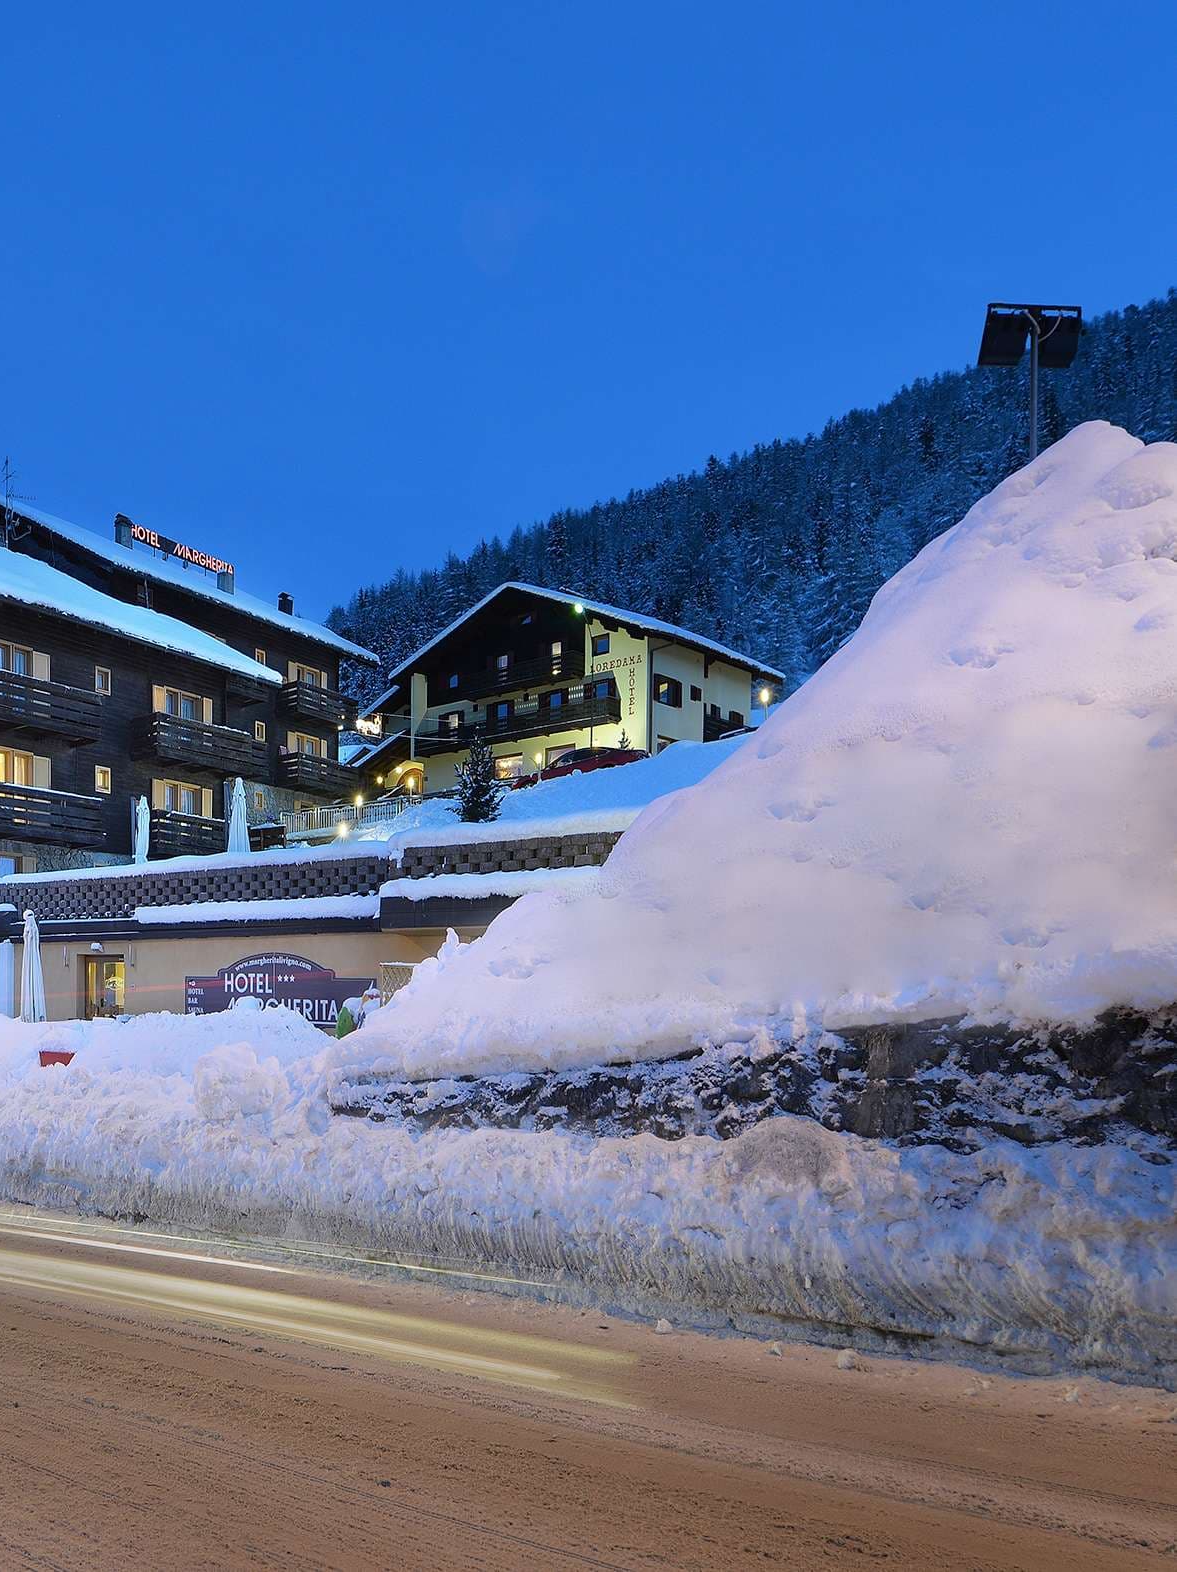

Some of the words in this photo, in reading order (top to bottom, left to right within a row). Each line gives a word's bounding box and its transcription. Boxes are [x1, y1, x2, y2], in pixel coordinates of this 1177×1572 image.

[131, 524, 160, 548] HOTEL
[173, 543, 234, 575] MARGHERITA
[590, 654, 642, 674] LOREDANA
[224, 973, 273, 994] HOTEL
[227, 997, 338, 1021] ERITA
